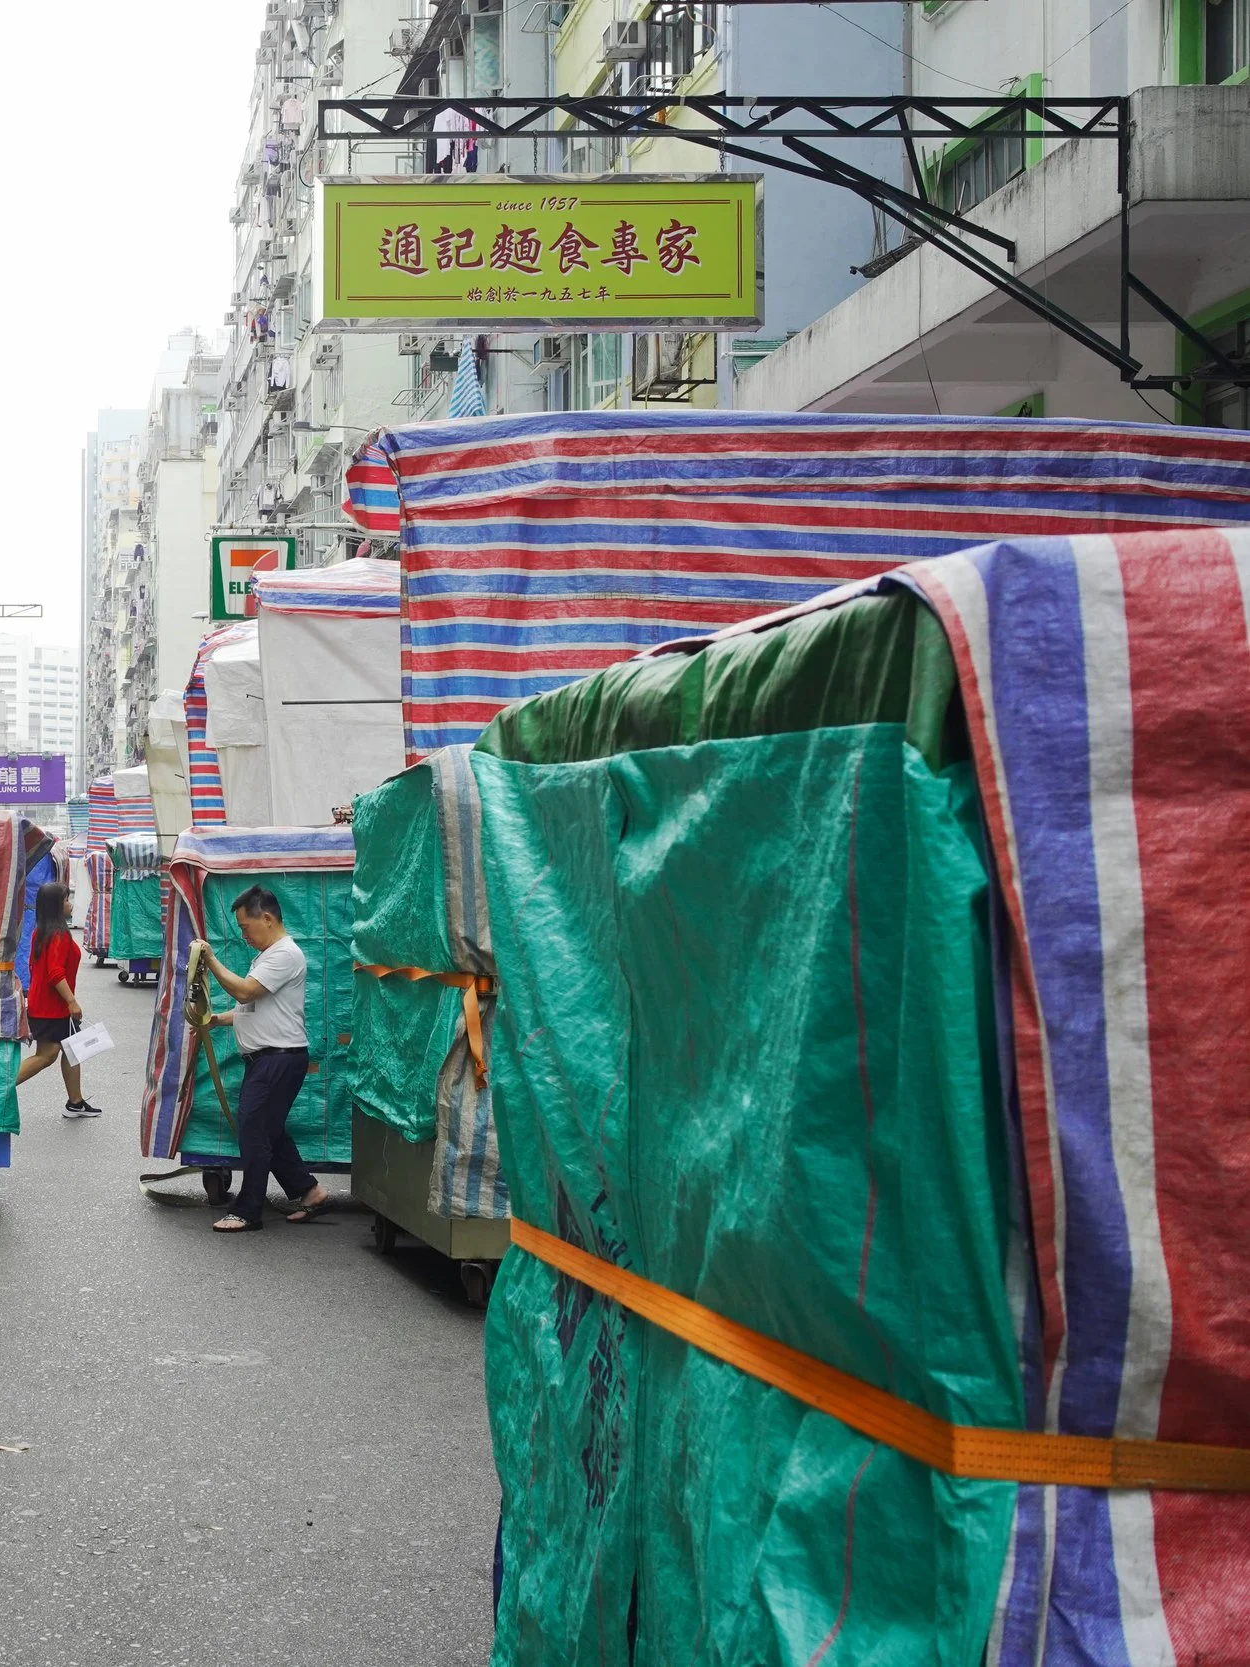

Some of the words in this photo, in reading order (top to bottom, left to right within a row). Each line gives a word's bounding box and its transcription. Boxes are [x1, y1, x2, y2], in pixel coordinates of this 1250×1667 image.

[495, 199, 533, 212] since
[539, 195, 579, 212] 1957
[377, 218, 702, 278] 通記麵食專家
[466, 286, 611, 303] 始創於一九五七年
